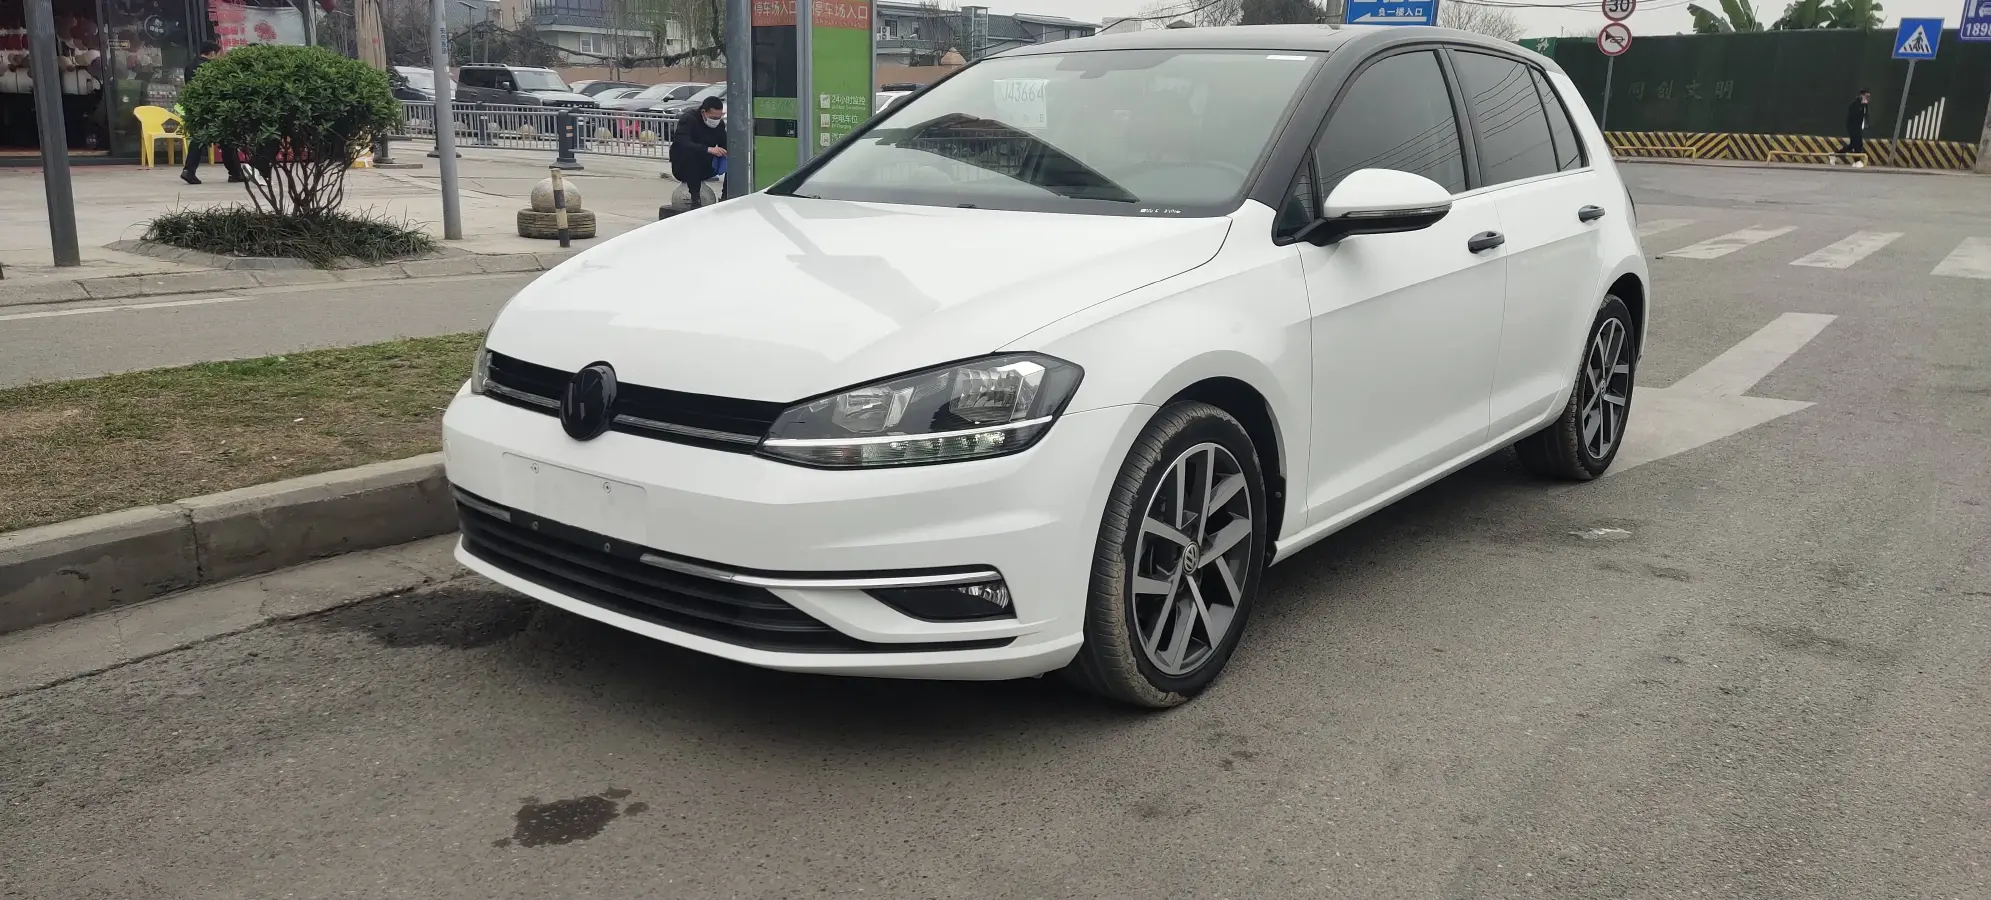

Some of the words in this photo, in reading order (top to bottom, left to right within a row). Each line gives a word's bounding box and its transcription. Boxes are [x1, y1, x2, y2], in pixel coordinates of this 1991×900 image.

[755, 1, 797, 17] 停车场入口
[812, 1, 868, 20] 停车场入口
[1378, 7, 1423, 16] 负一楼入口
[1608, 0, 1630, 12] 30
[831, 94, 866, 105] 24小时监控
[831, 113, 859, 124] 充电车位
